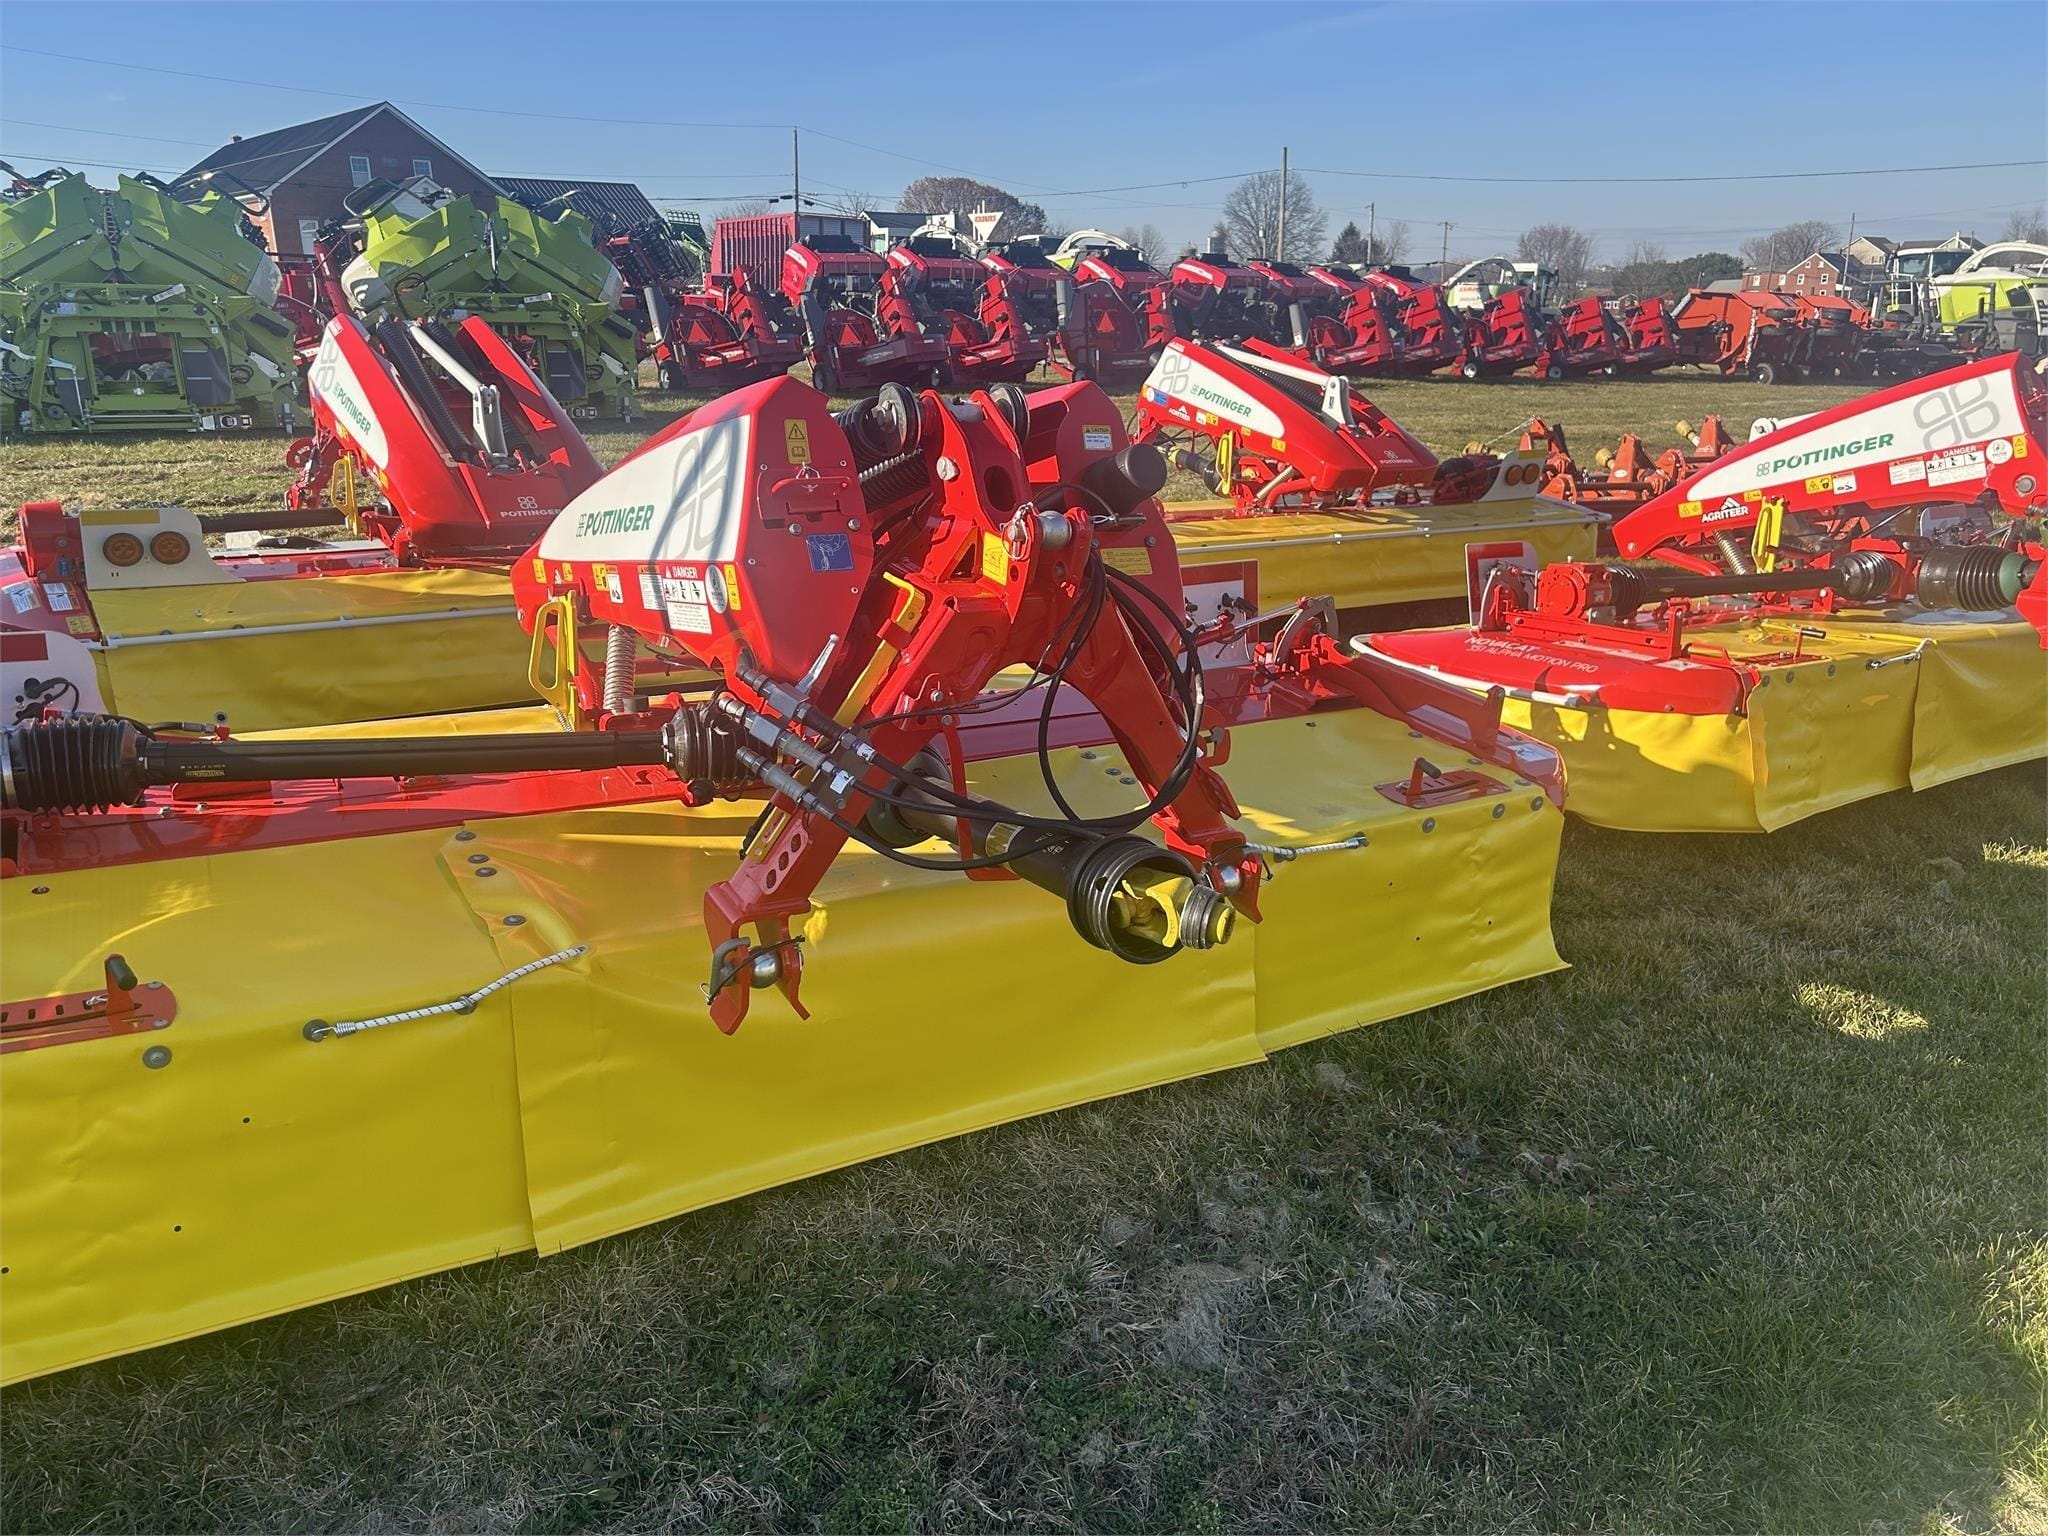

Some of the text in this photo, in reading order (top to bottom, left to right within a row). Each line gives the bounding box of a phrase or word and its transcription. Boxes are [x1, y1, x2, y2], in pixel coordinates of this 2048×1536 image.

[1943, 445, 1977, 458] DANGER
[1701, 506, 1749, 523] AGRITEER
[671, 565, 698, 579] DANGER
[1464, 637, 1541, 652] NOVACAT
[1485, 646, 1523, 659] ALPHA
[1523, 654, 1572, 668] MOTION
[1570, 661, 1600, 673] PRO
